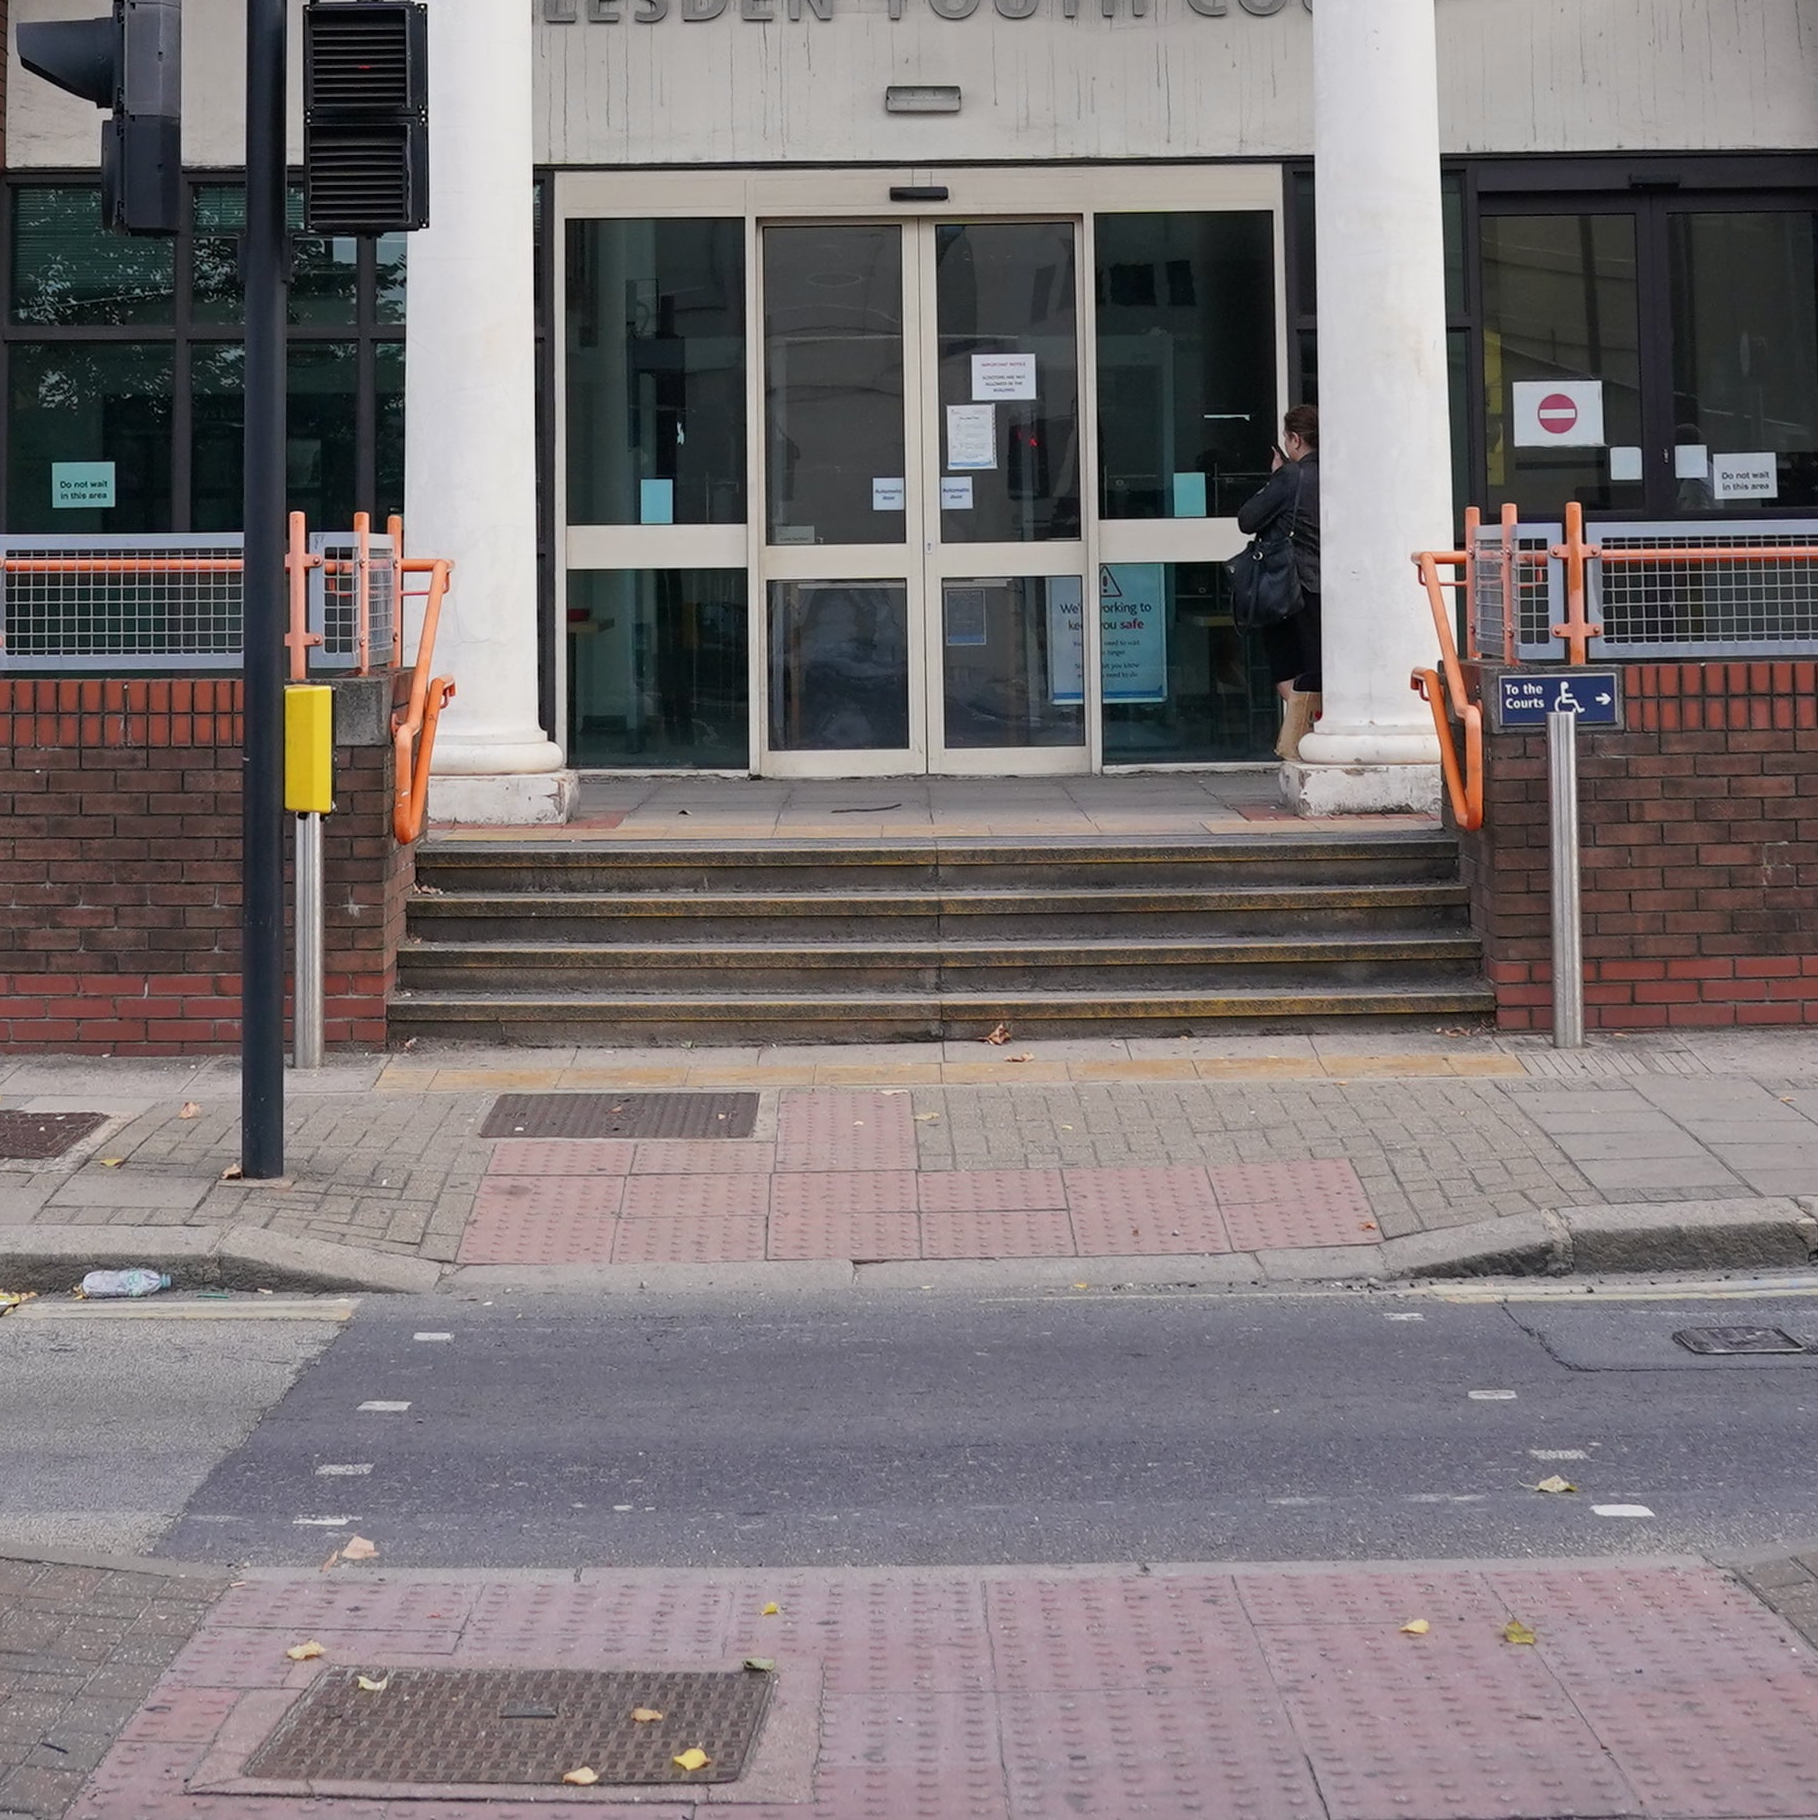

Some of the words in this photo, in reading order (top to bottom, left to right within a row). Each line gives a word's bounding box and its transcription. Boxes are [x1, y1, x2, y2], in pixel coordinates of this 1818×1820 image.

[1721, 471, 1734, 481] Do
[1735, 470, 1750, 480] not
[1751, 470, 1770, 480] wait
[60, 480, 72, 489] Do
[73, 480, 89, 489] not
[90, 480, 108, 488] wait
[1732, 483, 1749, 491] this
[1751, 482, 1770, 490] area
[70, 492, 87, 500] this
[88, 492, 108, 500] area
[1140, 602, 1152, 613] to
[1119, 617, 1145, 630] safe
[1504, 683, 1520, 696] To
[1522, 682, 1544, 696] the
[1504, 697, 1545, 710] Courts
